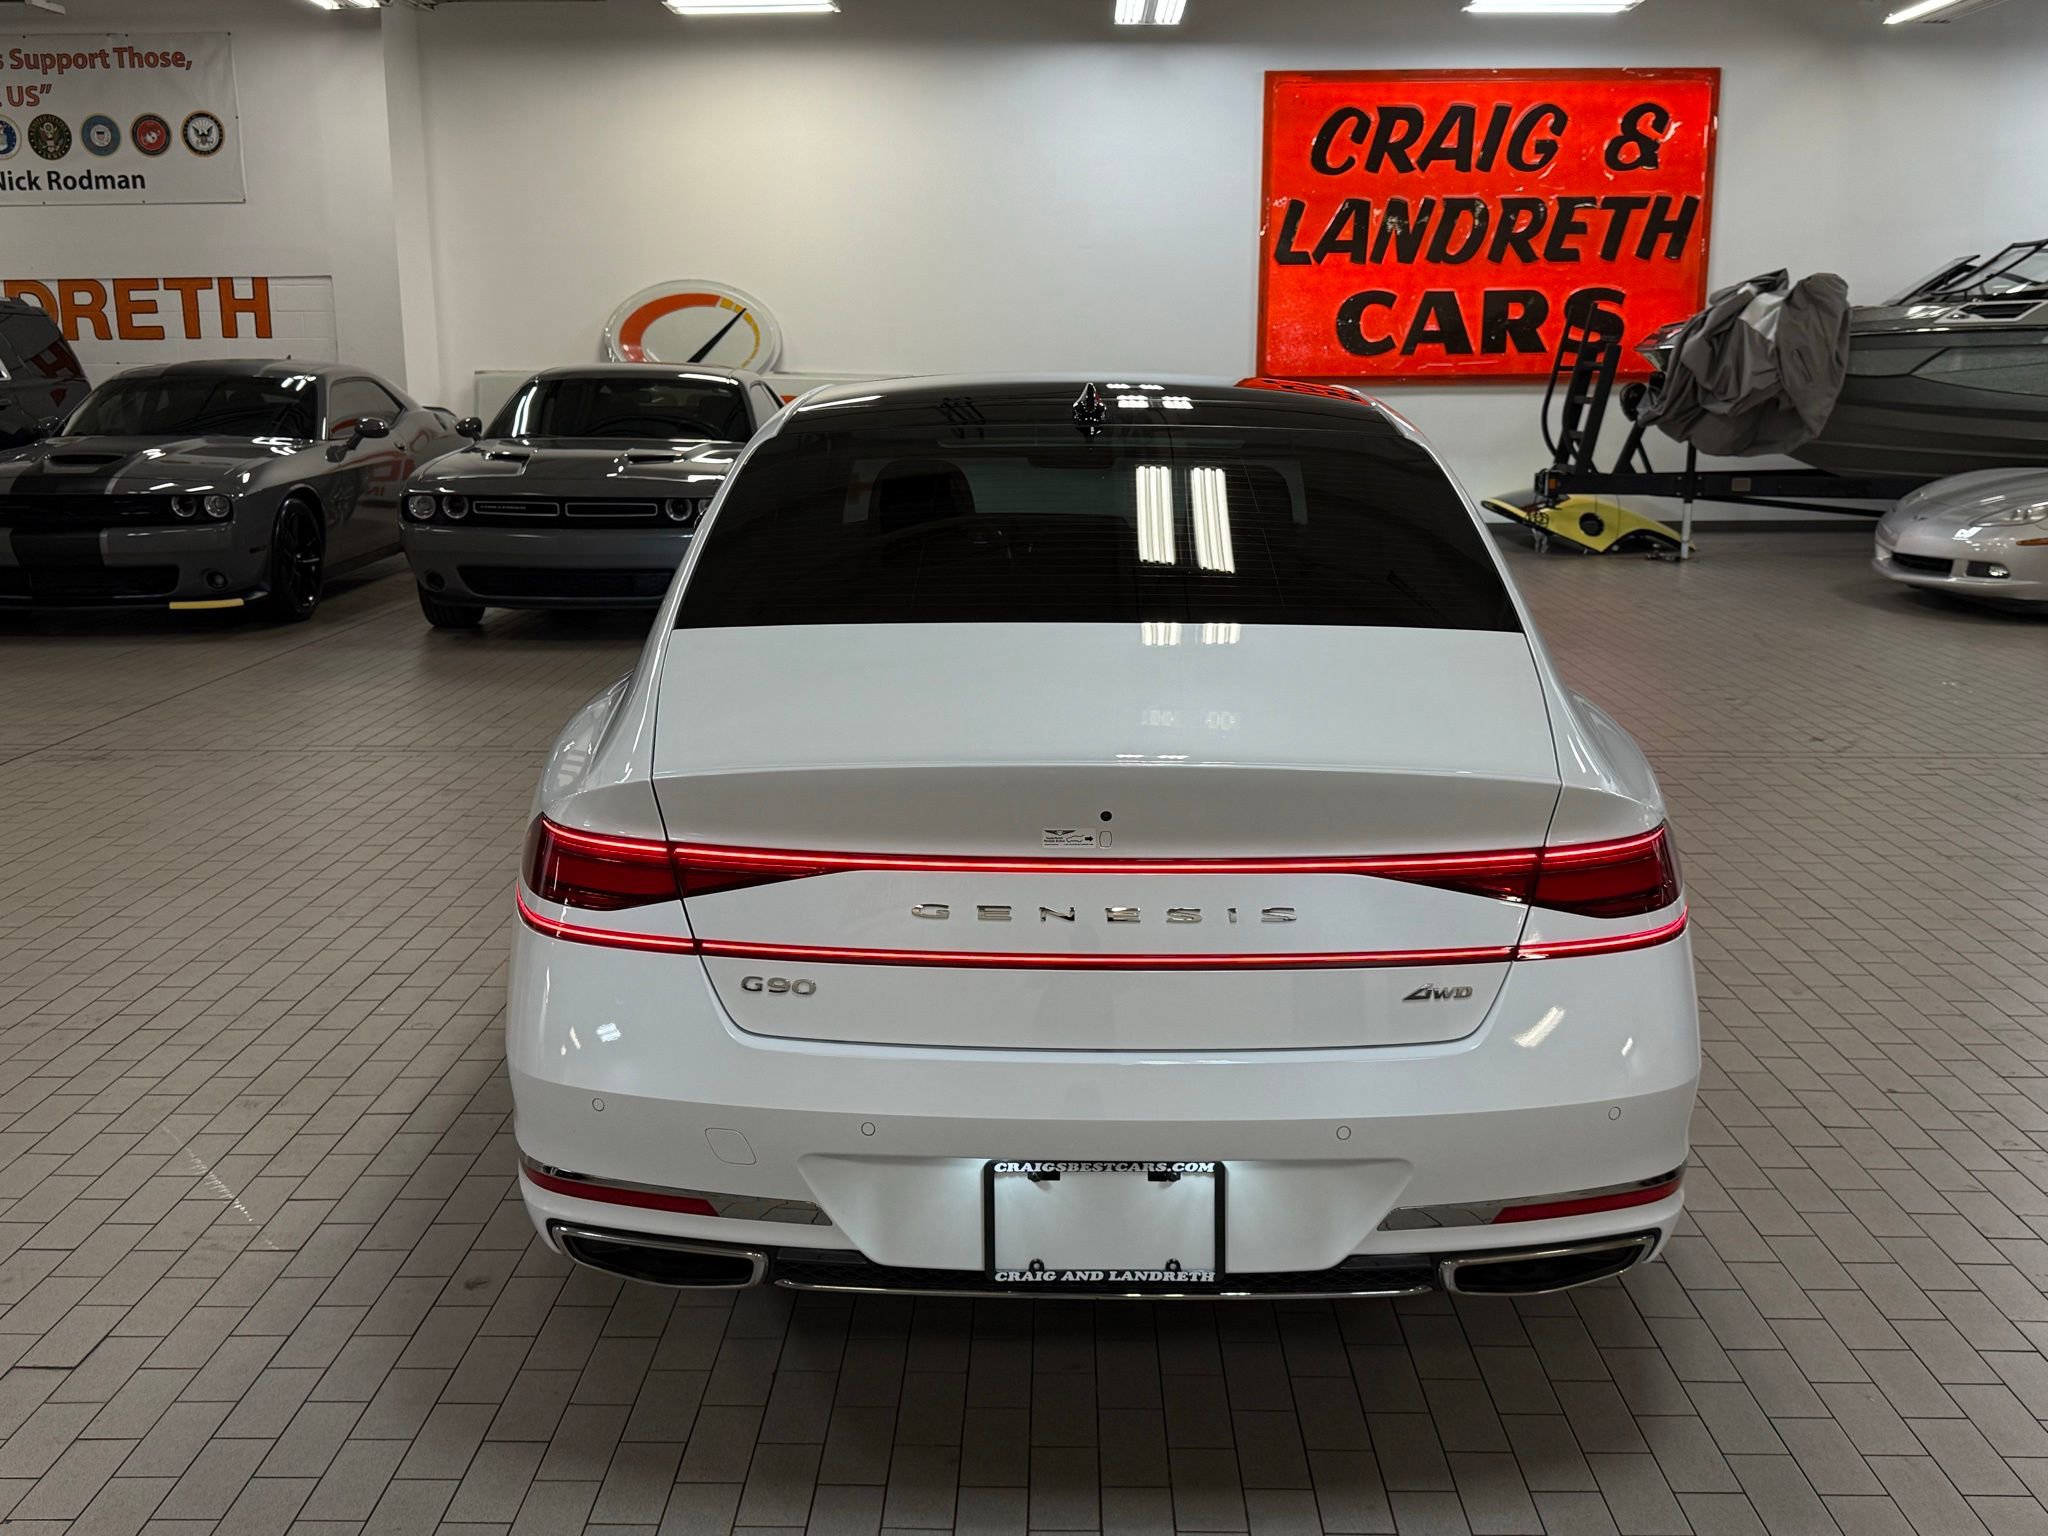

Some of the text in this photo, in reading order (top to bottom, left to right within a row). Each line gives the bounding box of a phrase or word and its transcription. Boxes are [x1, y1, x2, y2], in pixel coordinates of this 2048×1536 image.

[9, 48, 110, 75] Support
[114, 46, 192, 71] Those,
[1311, 102, 1670, 176] CRAIG &
[46, 168, 146, 191] Rodman
[1274, 196, 1699, 265] LANDRETH
[1336, 286, 1626, 357] CARS
[911, 903, 1297, 923] GENESIS
[741, 976, 817, 995] G90
[993, 1162, 1216, 1173] CRAIGSBESTCARS.COM
[994, 1270, 1216, 1283] CRAIG AND LANDRETH
